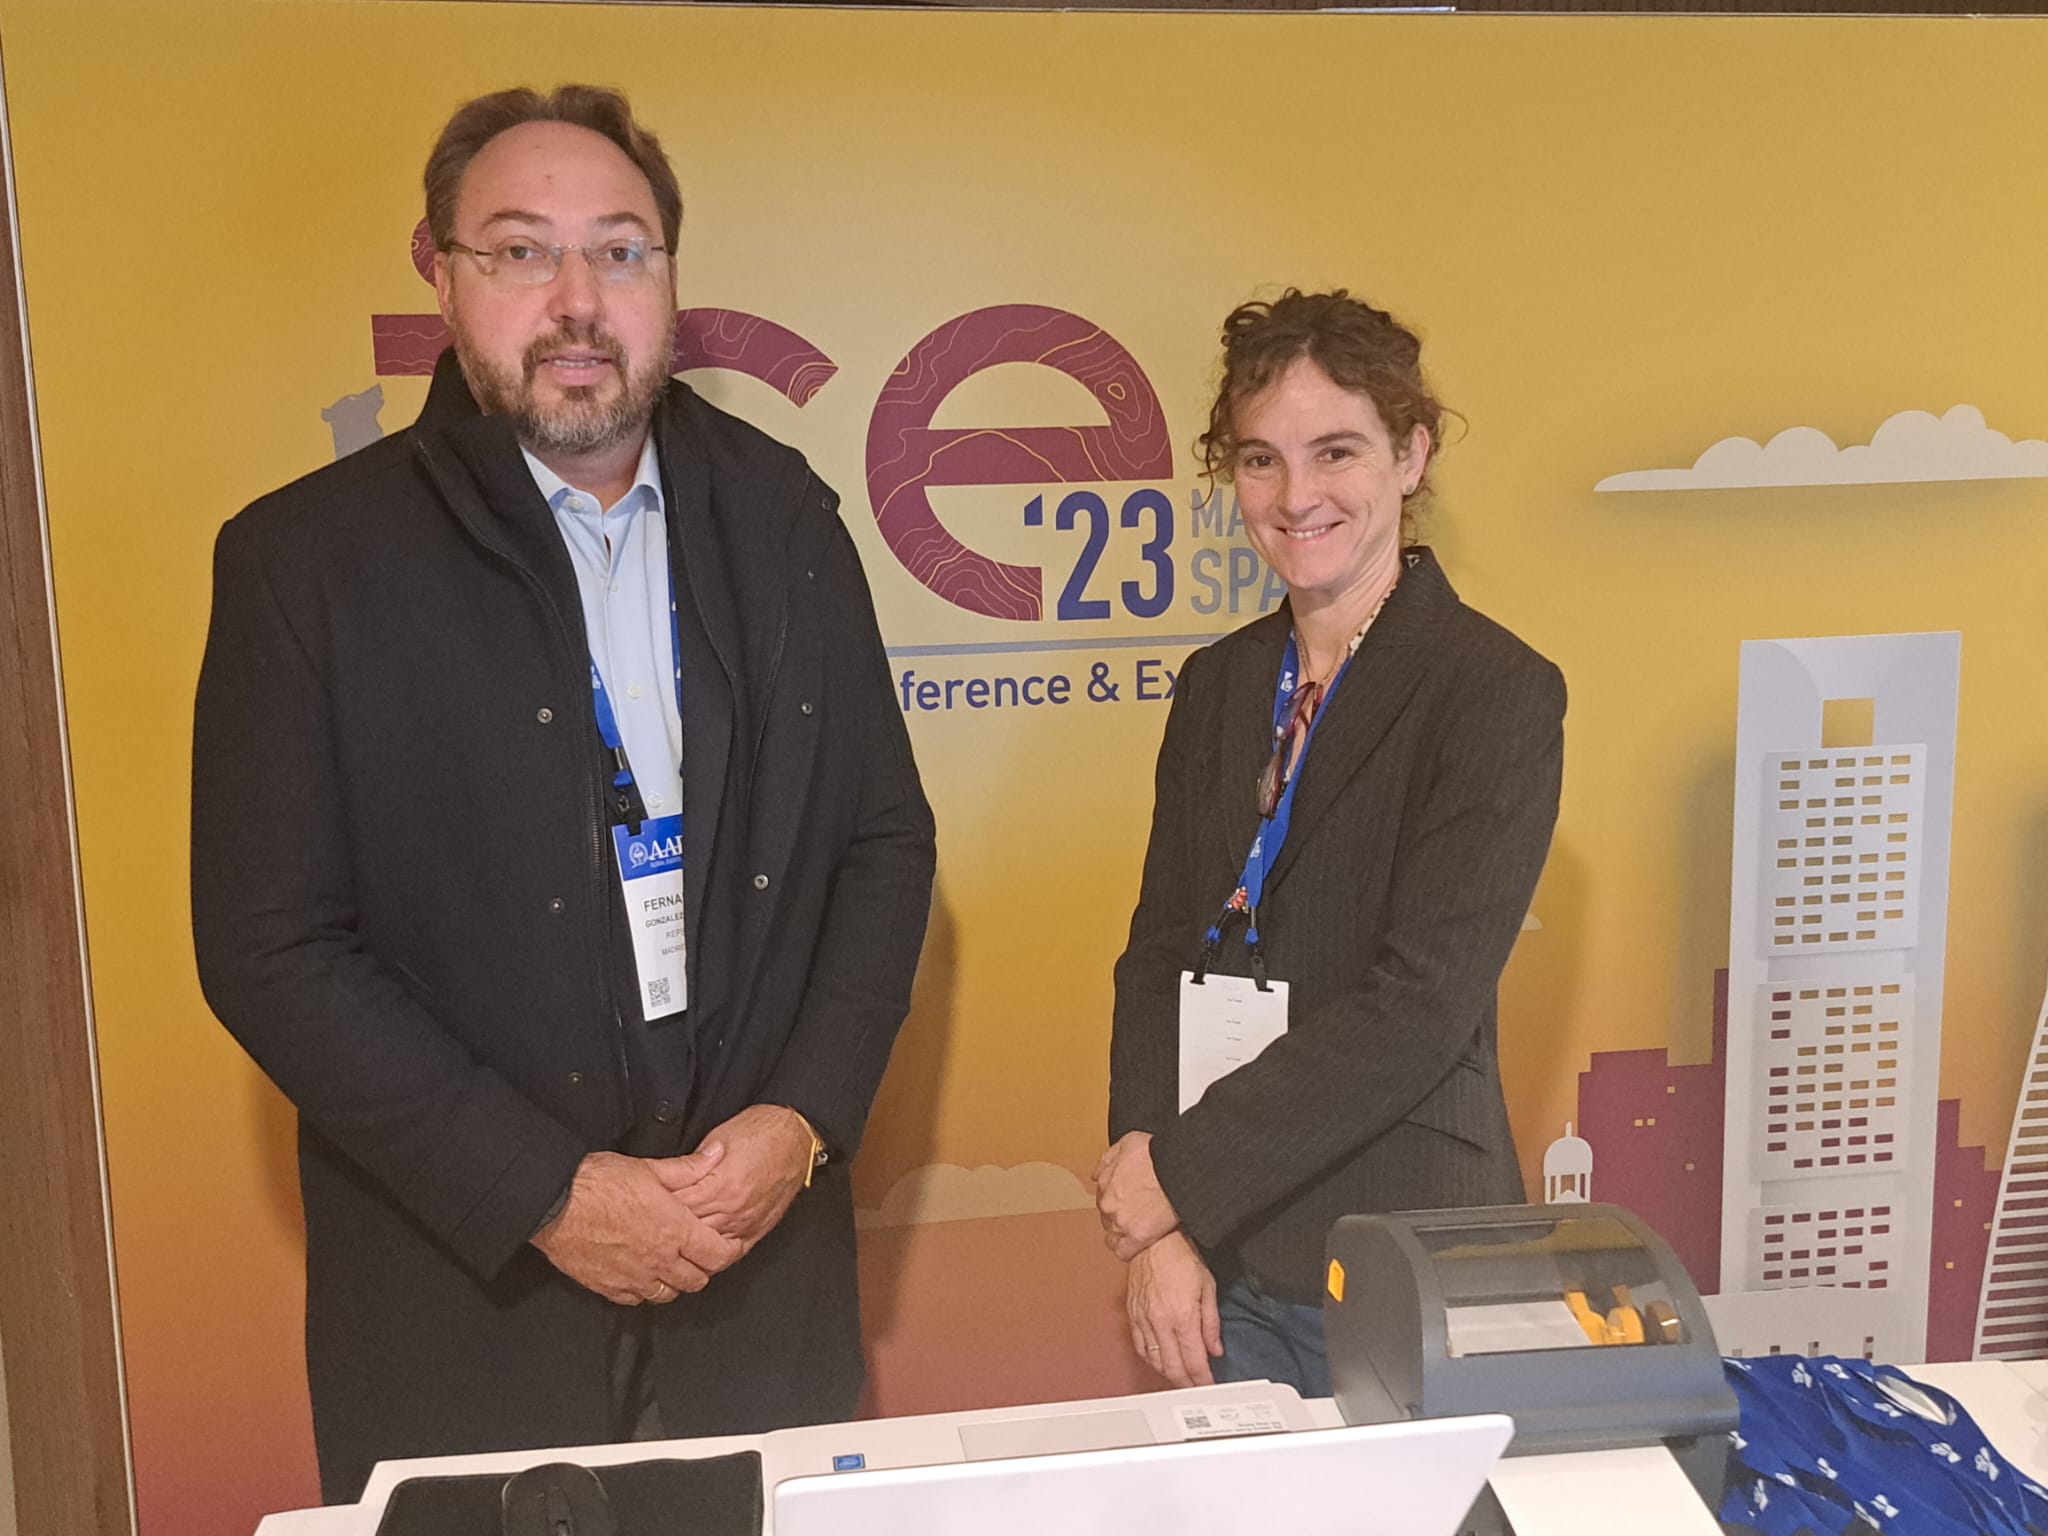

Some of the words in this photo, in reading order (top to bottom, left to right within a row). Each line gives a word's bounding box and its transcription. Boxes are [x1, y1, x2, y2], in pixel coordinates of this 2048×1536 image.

[1023, 488, 1175, 621] '23
[1190, 547, 1289, 616] SPA
[899, 670, 1071, 712] ference
[1086, 661, 1120, 703] &
[643, 893, 683, 912] FERNA
